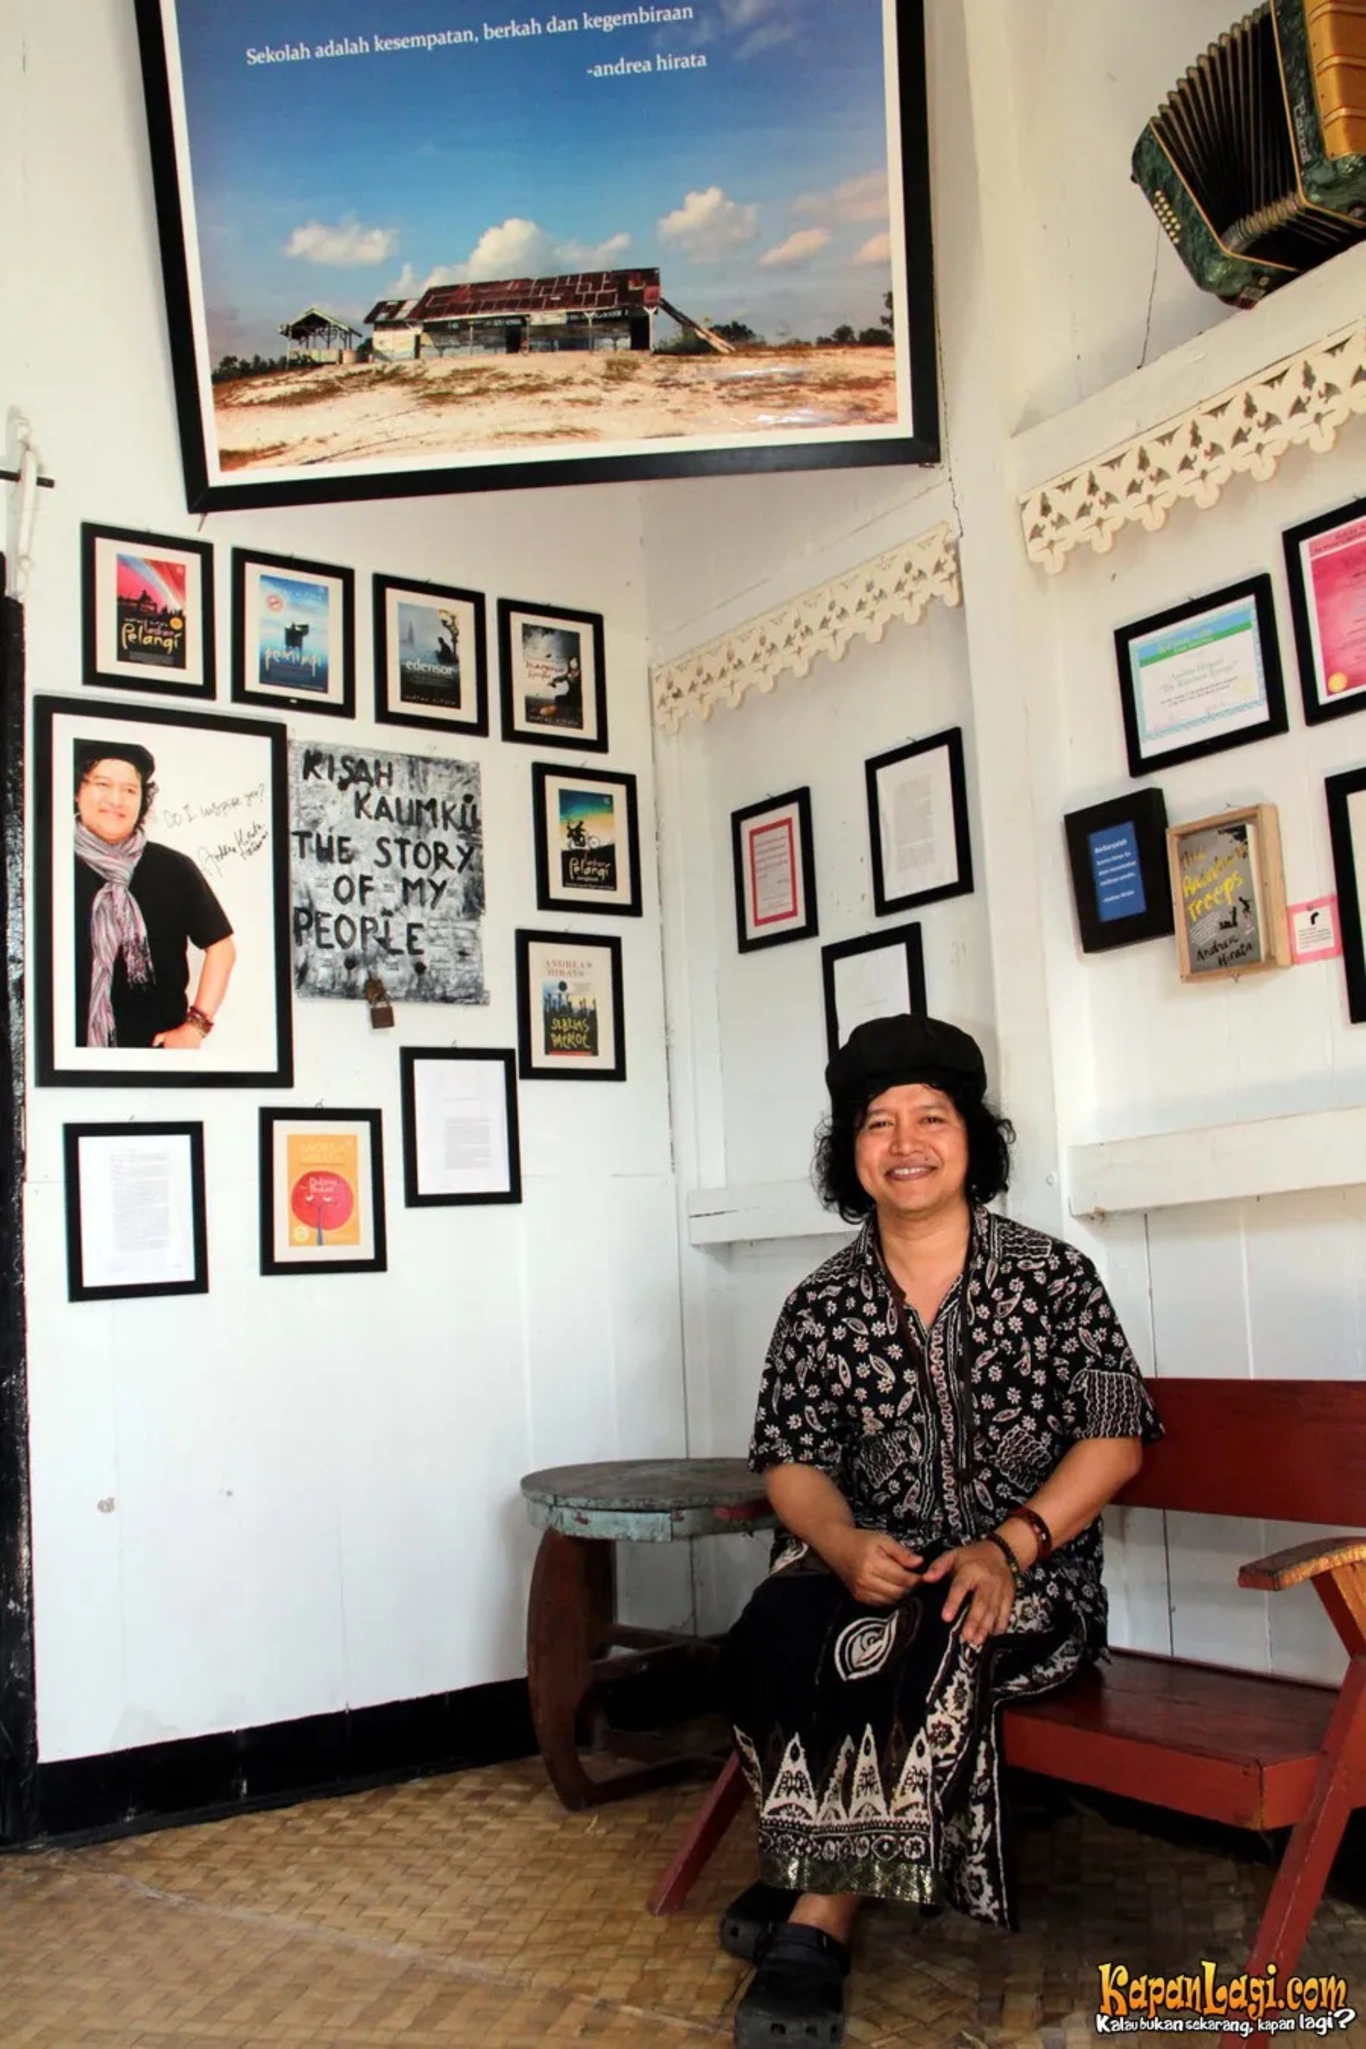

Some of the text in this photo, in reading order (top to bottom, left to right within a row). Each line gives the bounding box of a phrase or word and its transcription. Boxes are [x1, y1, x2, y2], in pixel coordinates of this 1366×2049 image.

[246, 6, 694, 65] Sekolah adalah kesempatan, berkah dan kegembiraan
[587, 53, 707, 77] -andrea hirata
[406, 659, 453, 675] edensor
[303, 749, 393, 789] KISAH
[354, 791, 479, 833] KAUMKU
[291, 831, 351, 864] THE
[374, 836, 475, 873] STORY
[333, 874, 447, 909] OF MY
[293, 907, 424, 955] PEOPLE
